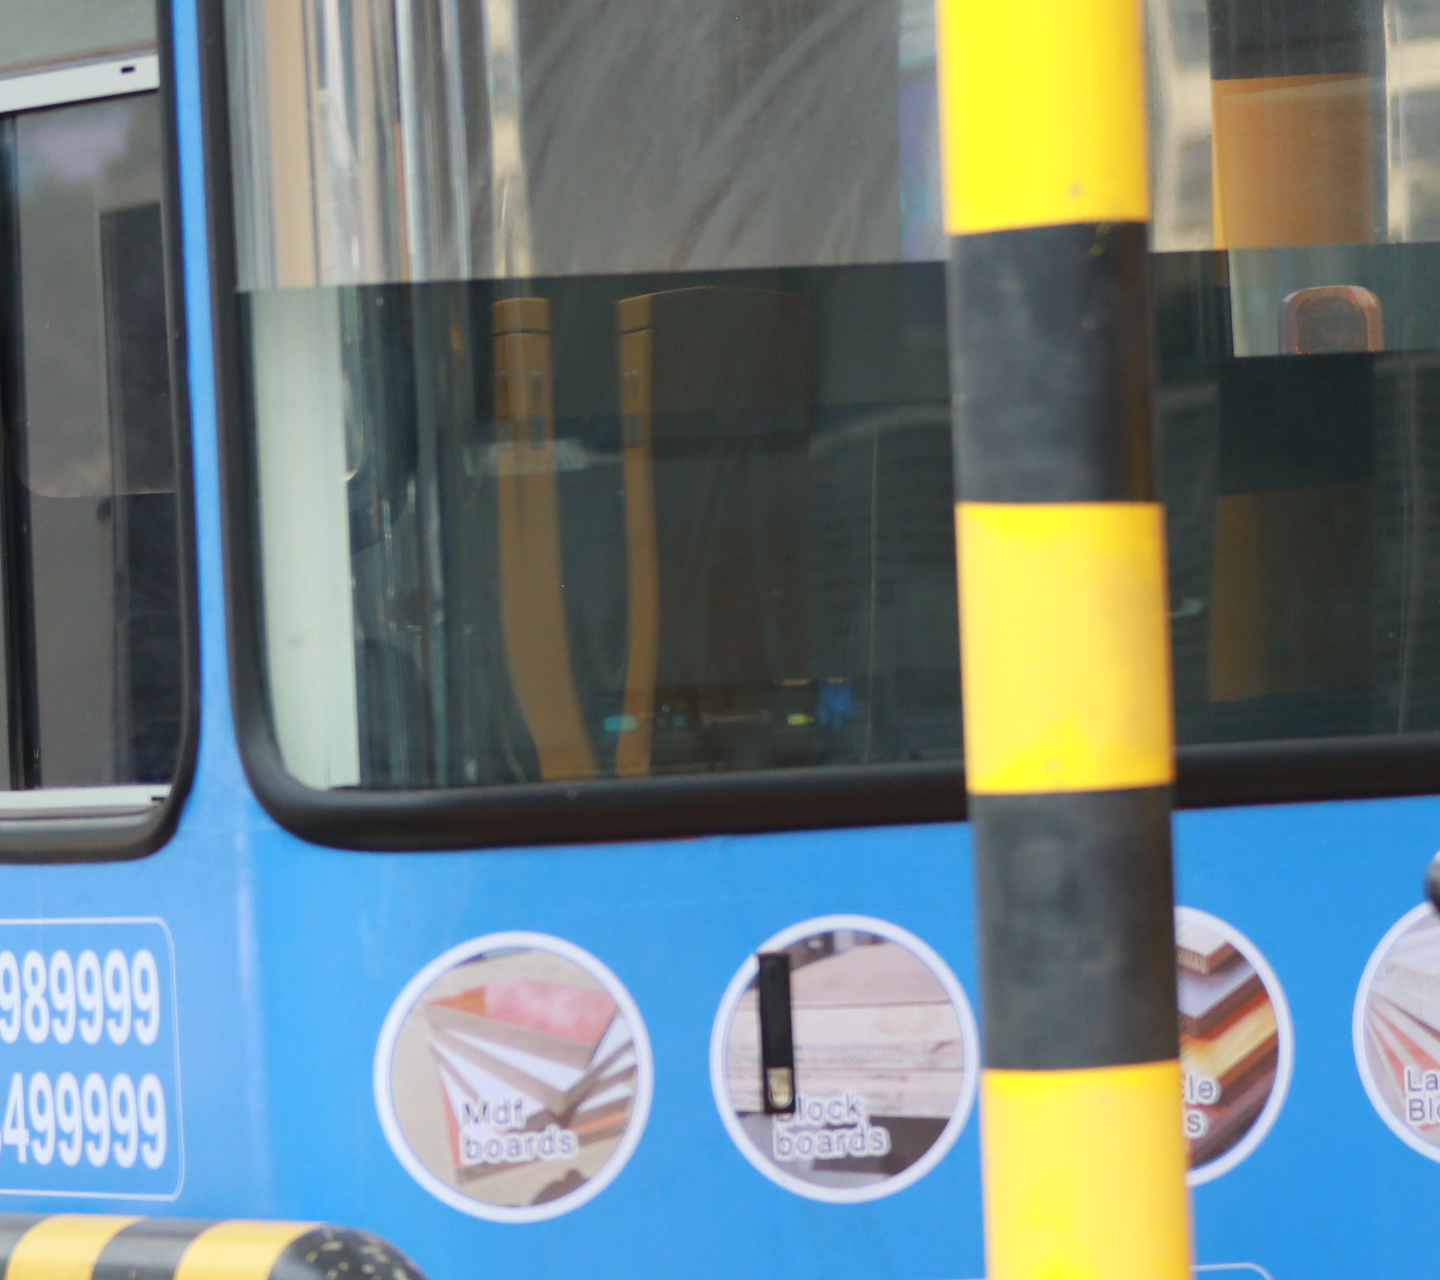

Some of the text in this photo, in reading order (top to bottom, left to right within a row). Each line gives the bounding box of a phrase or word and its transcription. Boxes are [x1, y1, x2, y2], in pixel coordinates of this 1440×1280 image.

[460, 1100, 527, 1128] Mdf
[462, 1126, 578, 1162] boards
[774, 1124, 888, 1161] boards
